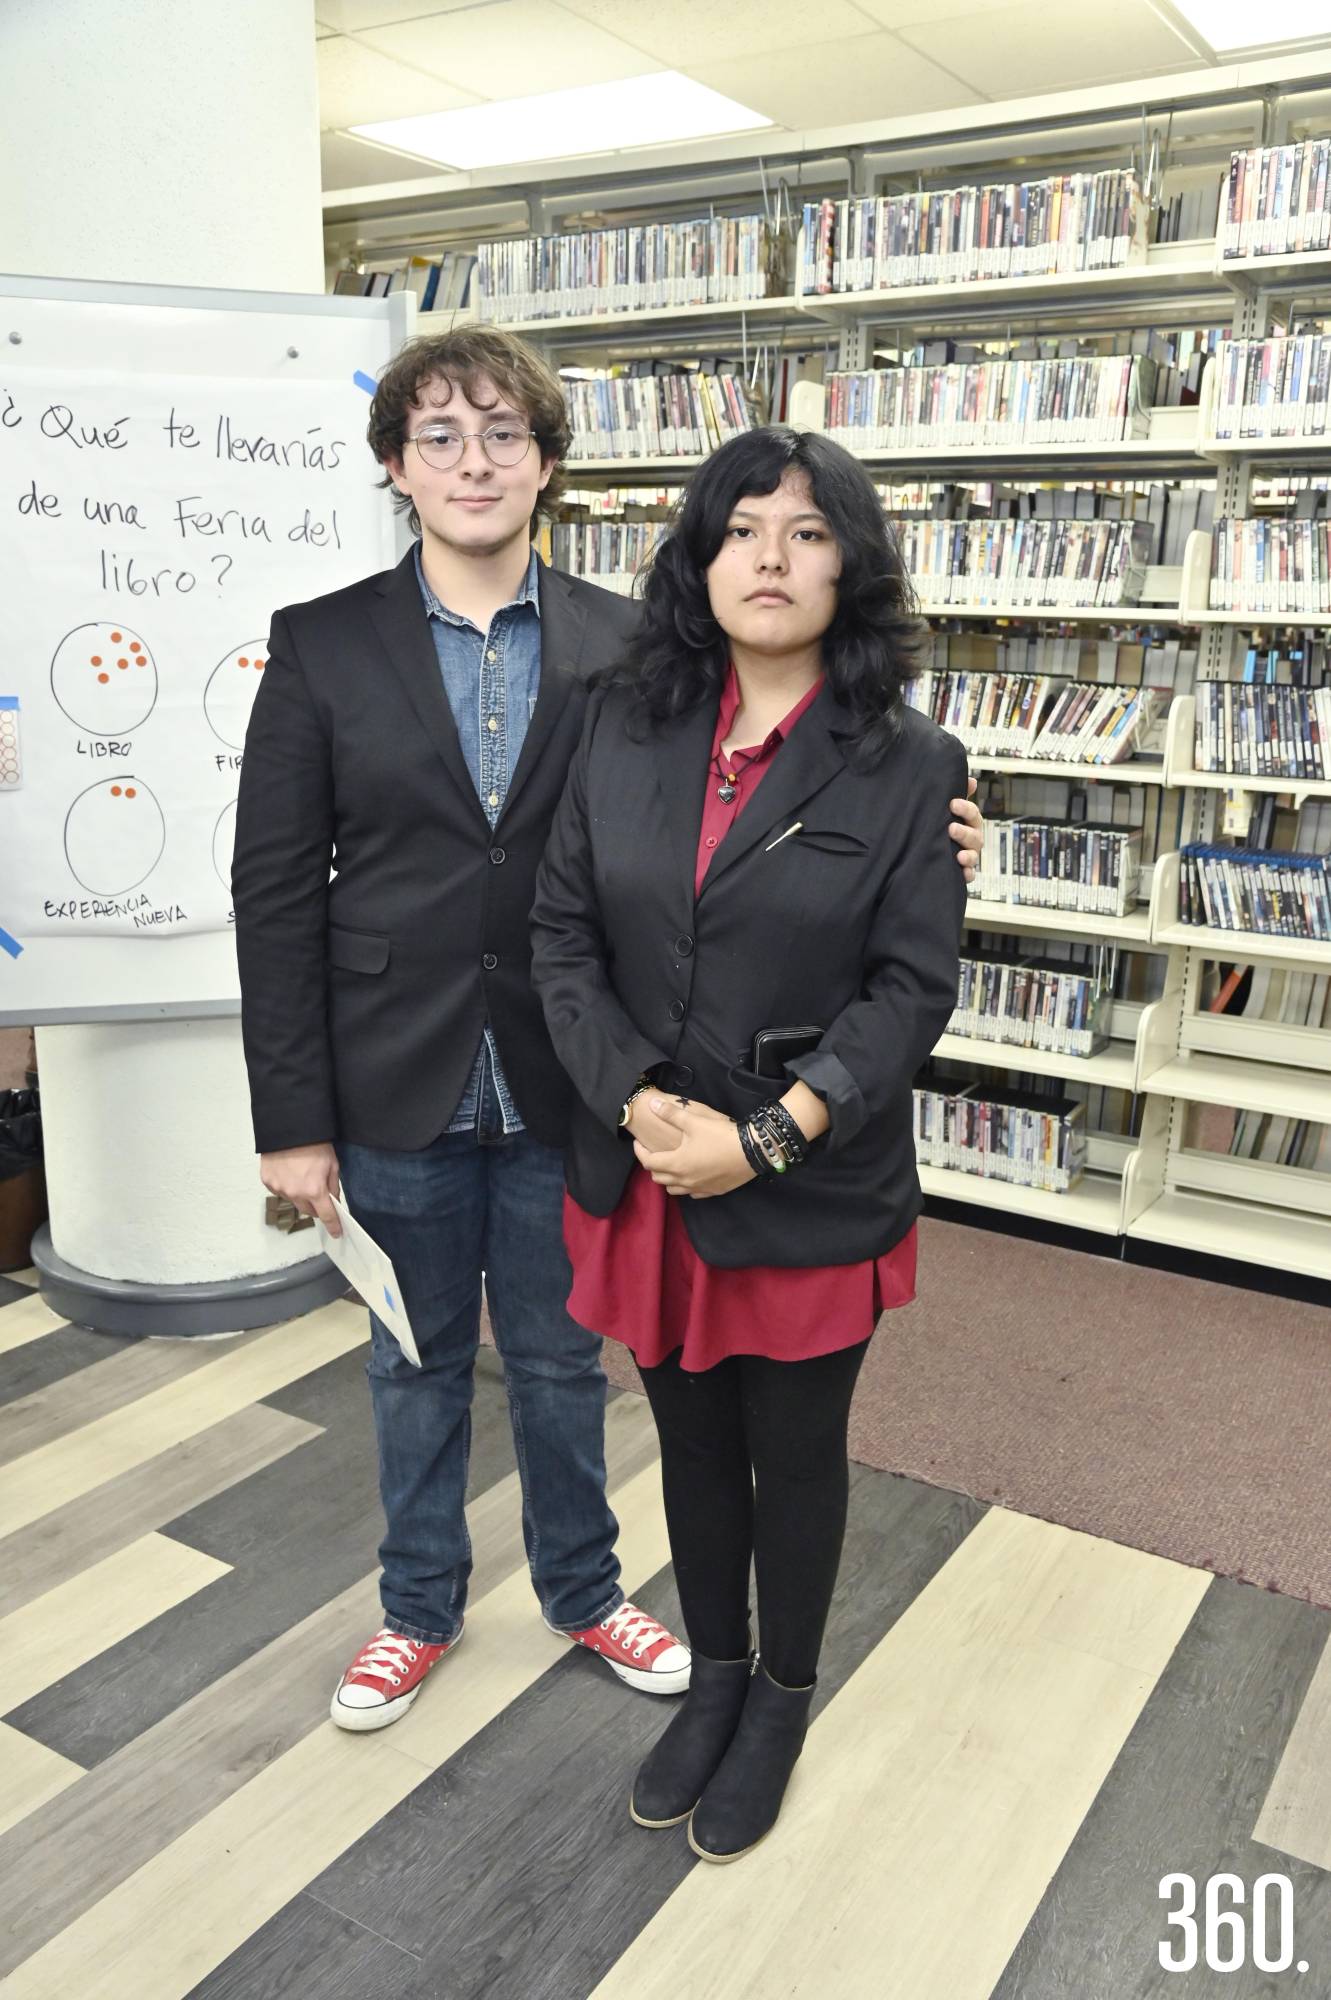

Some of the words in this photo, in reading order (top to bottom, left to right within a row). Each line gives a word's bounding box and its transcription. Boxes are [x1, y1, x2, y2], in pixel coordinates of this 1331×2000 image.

[163, 407, 200, 448] te
[216, 415, 346, 471] llevarías
[18, 480, 62, 518] de
[84, 498, 146, 529] una
[173, 496, 272, 543] Feria
[288, 509, 341, 549] del
[76, 740, 132, 758] LIBRO
[214, 754, 243, 773] FIR
[133, 905, 188, 928] NUEVA
